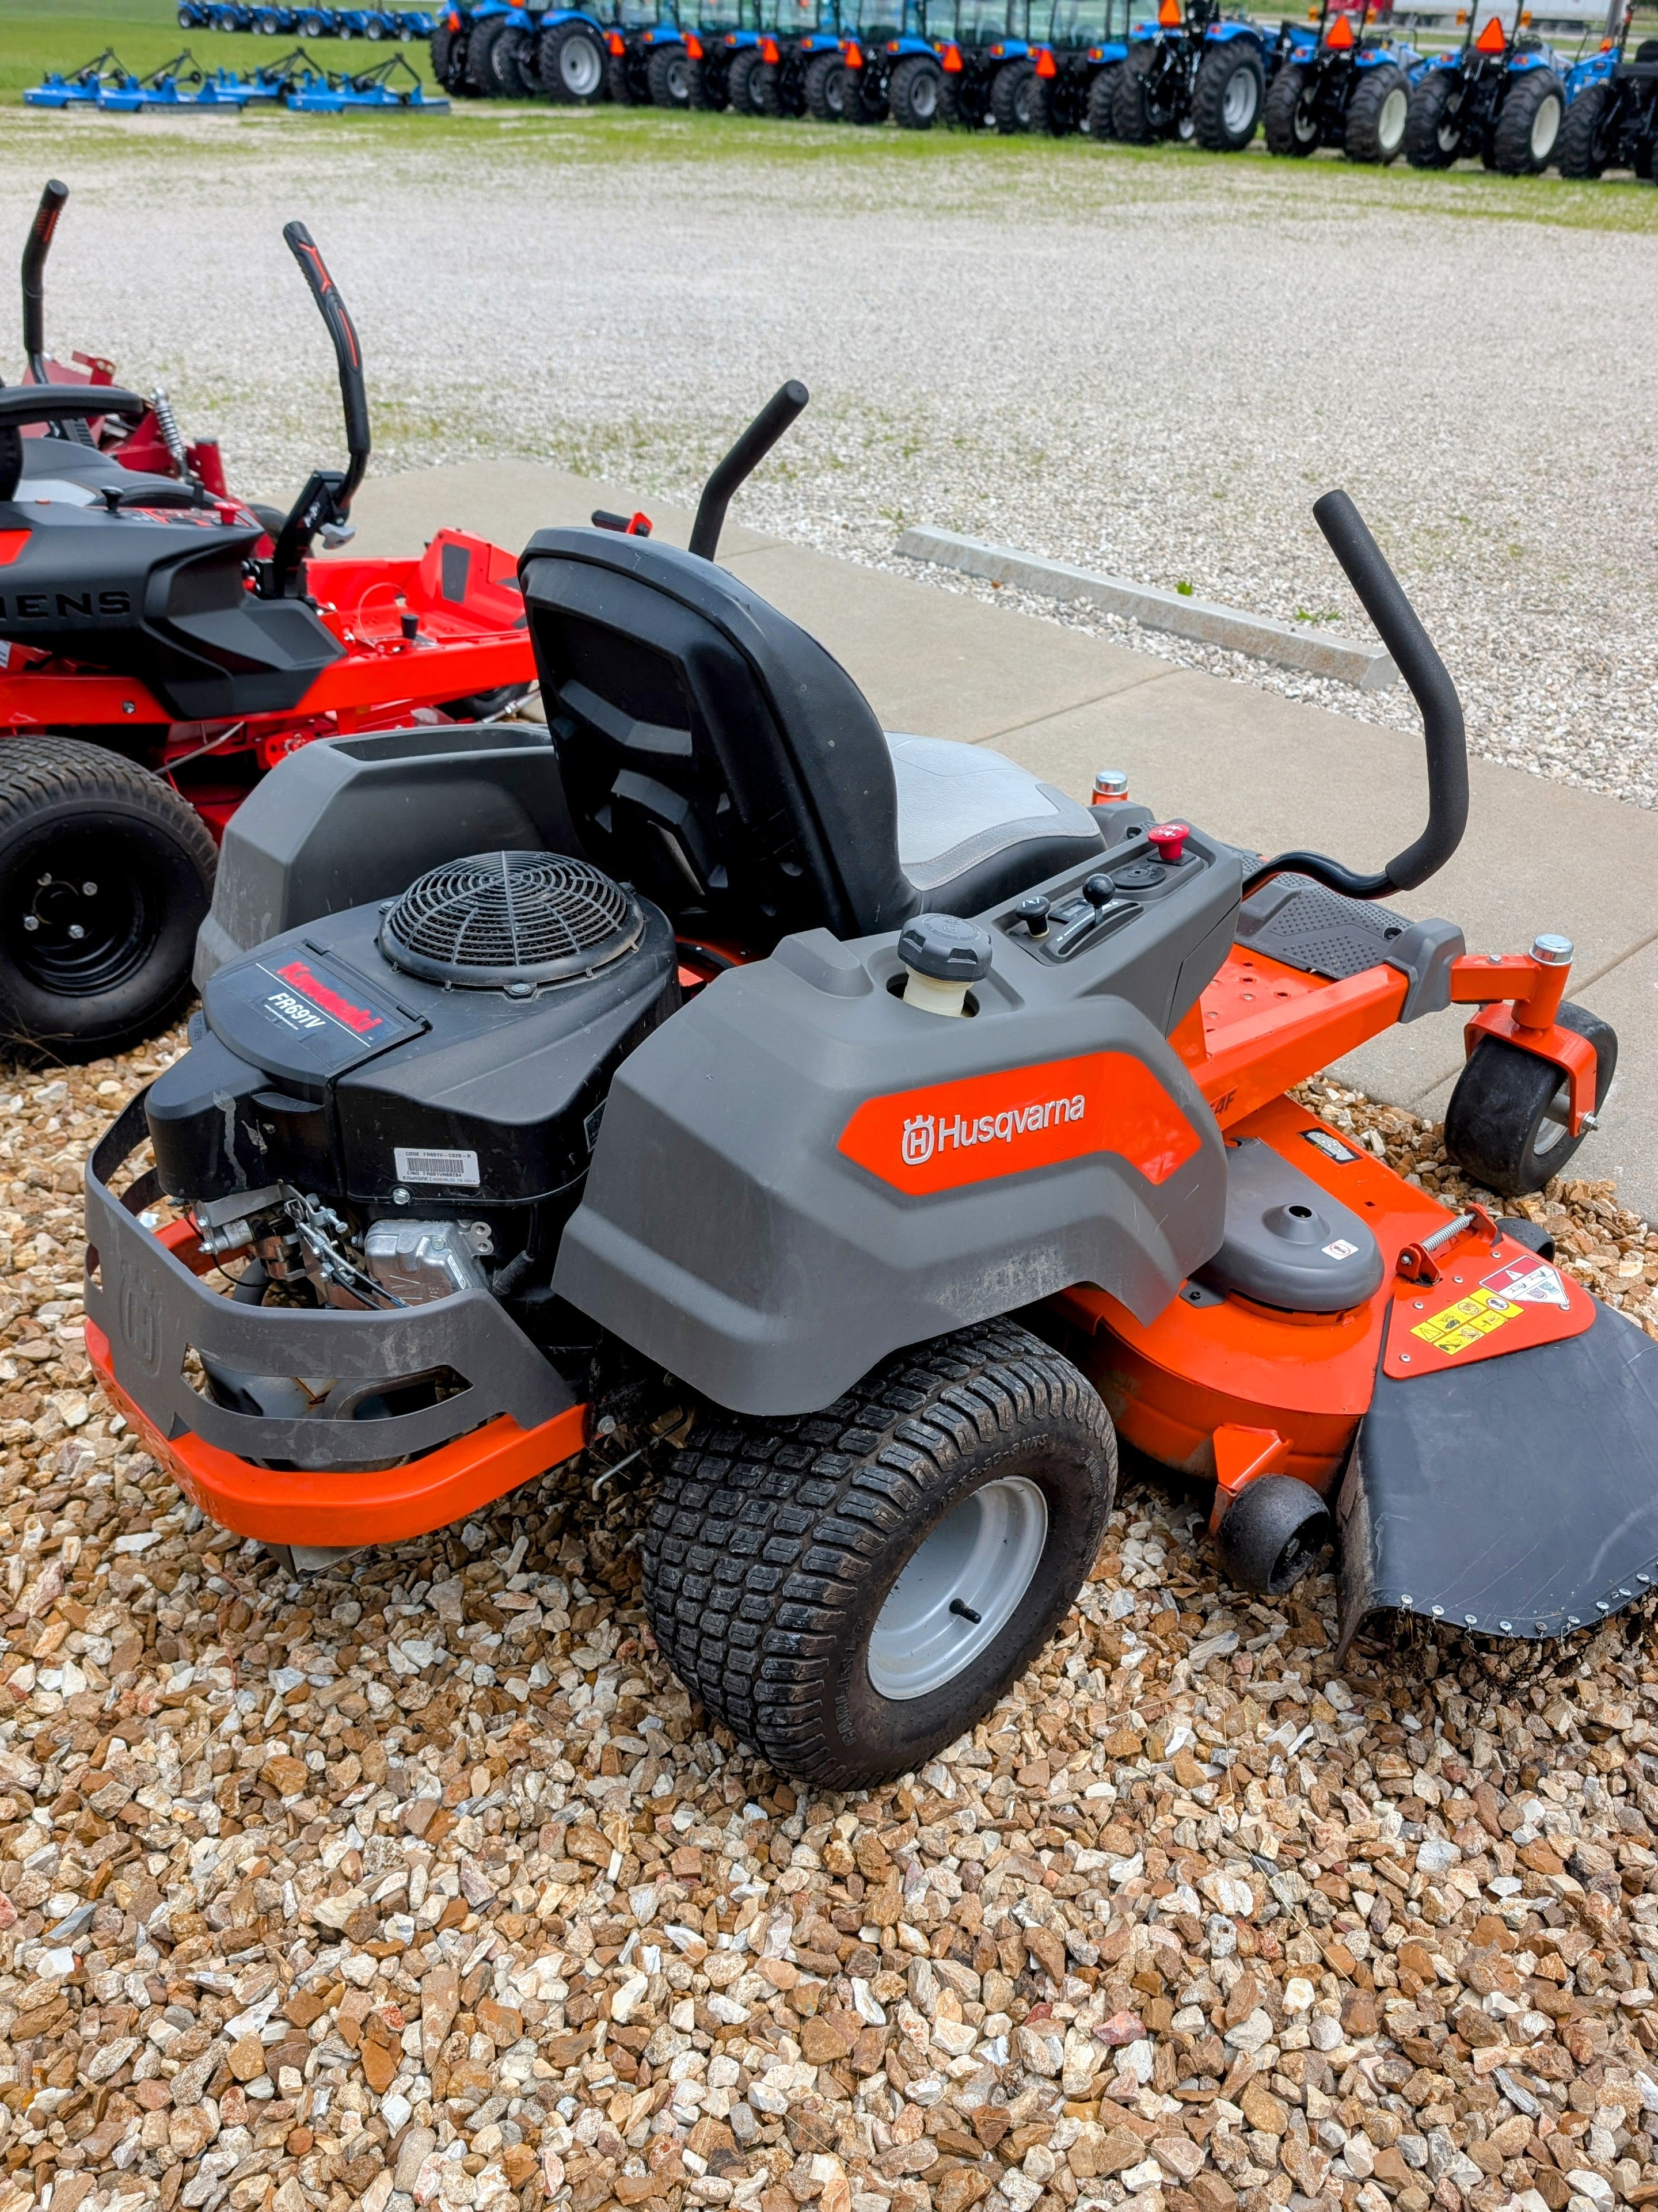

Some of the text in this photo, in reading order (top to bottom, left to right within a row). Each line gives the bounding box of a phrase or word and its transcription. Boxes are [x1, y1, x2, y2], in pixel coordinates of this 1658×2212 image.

[267, 992, 327, 1028] FR691V
[276, 961, 383, 1033] Kawasaki
[938, 1095, 1085, 1152] Husqvarna
